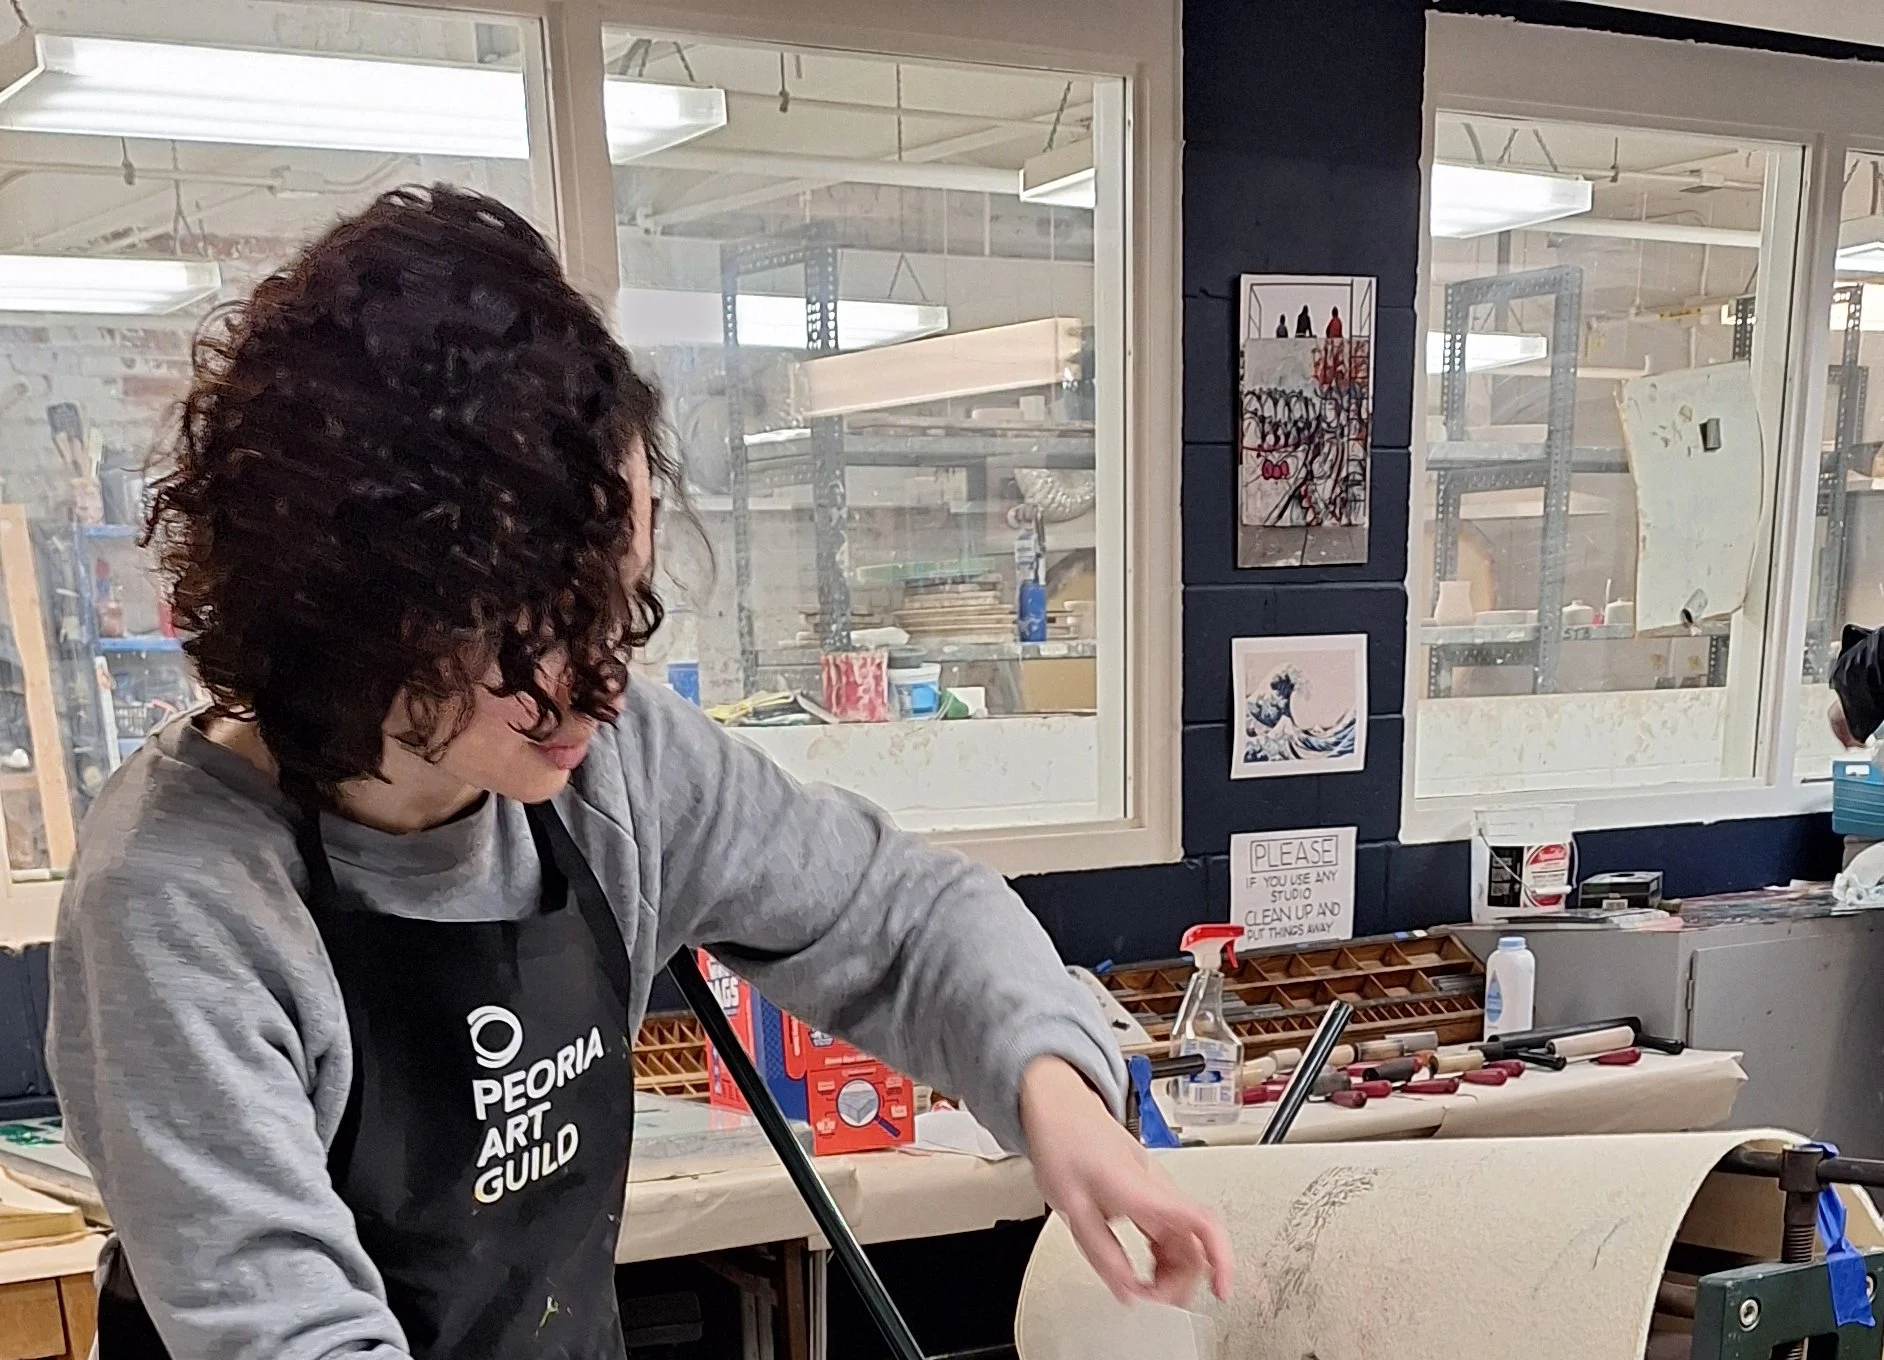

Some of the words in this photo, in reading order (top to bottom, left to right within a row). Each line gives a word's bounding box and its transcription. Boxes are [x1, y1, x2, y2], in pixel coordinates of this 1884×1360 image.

[1254, 838, 1334, 867] PLEASE
[1246, 876, 1257, 889] IF
[1263, 875, 1287, 888] YOU
[1290, 872, 1311, 886] USE
[1314, 869, 1338, 884] ANY
[1270, 887, 1312, 903] STUDIO
[1244, 905, 1292, 926] CLEAN
[1295, 903, 1314, 920] UP
[1316, 901, 1341, 918] AND
[1247, 928, 1266, 941] PUT
[1268, 923, 1304, 939] THINGS
[1306, 920, 1335, 934] AWAY
[471, 1025, 605, 1121] PEORIA
[476, 1100, 553, 1168] ART
[474, 1122, 579, 1204] GUILD
